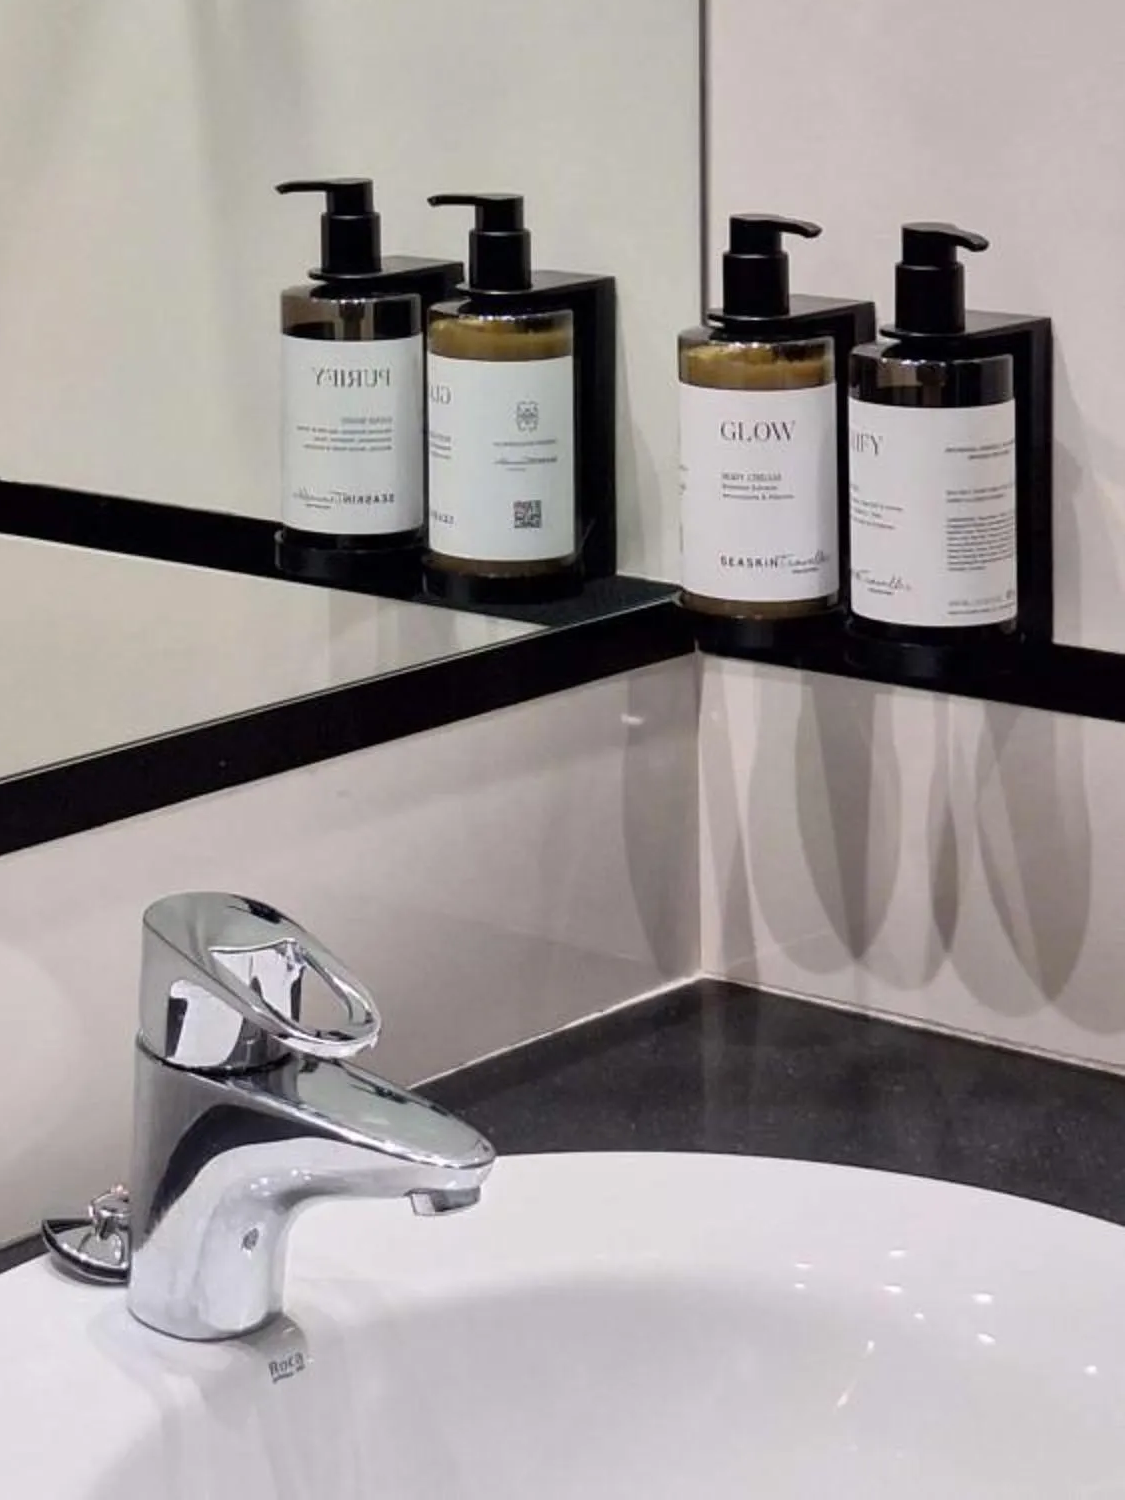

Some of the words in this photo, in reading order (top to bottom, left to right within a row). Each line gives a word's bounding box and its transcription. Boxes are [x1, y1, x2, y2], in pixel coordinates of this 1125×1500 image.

[719, 420, 796, 442] GLOW
[852, 432, 884, 456] IFY
[719, 555, 778, 569] SEASKIN
